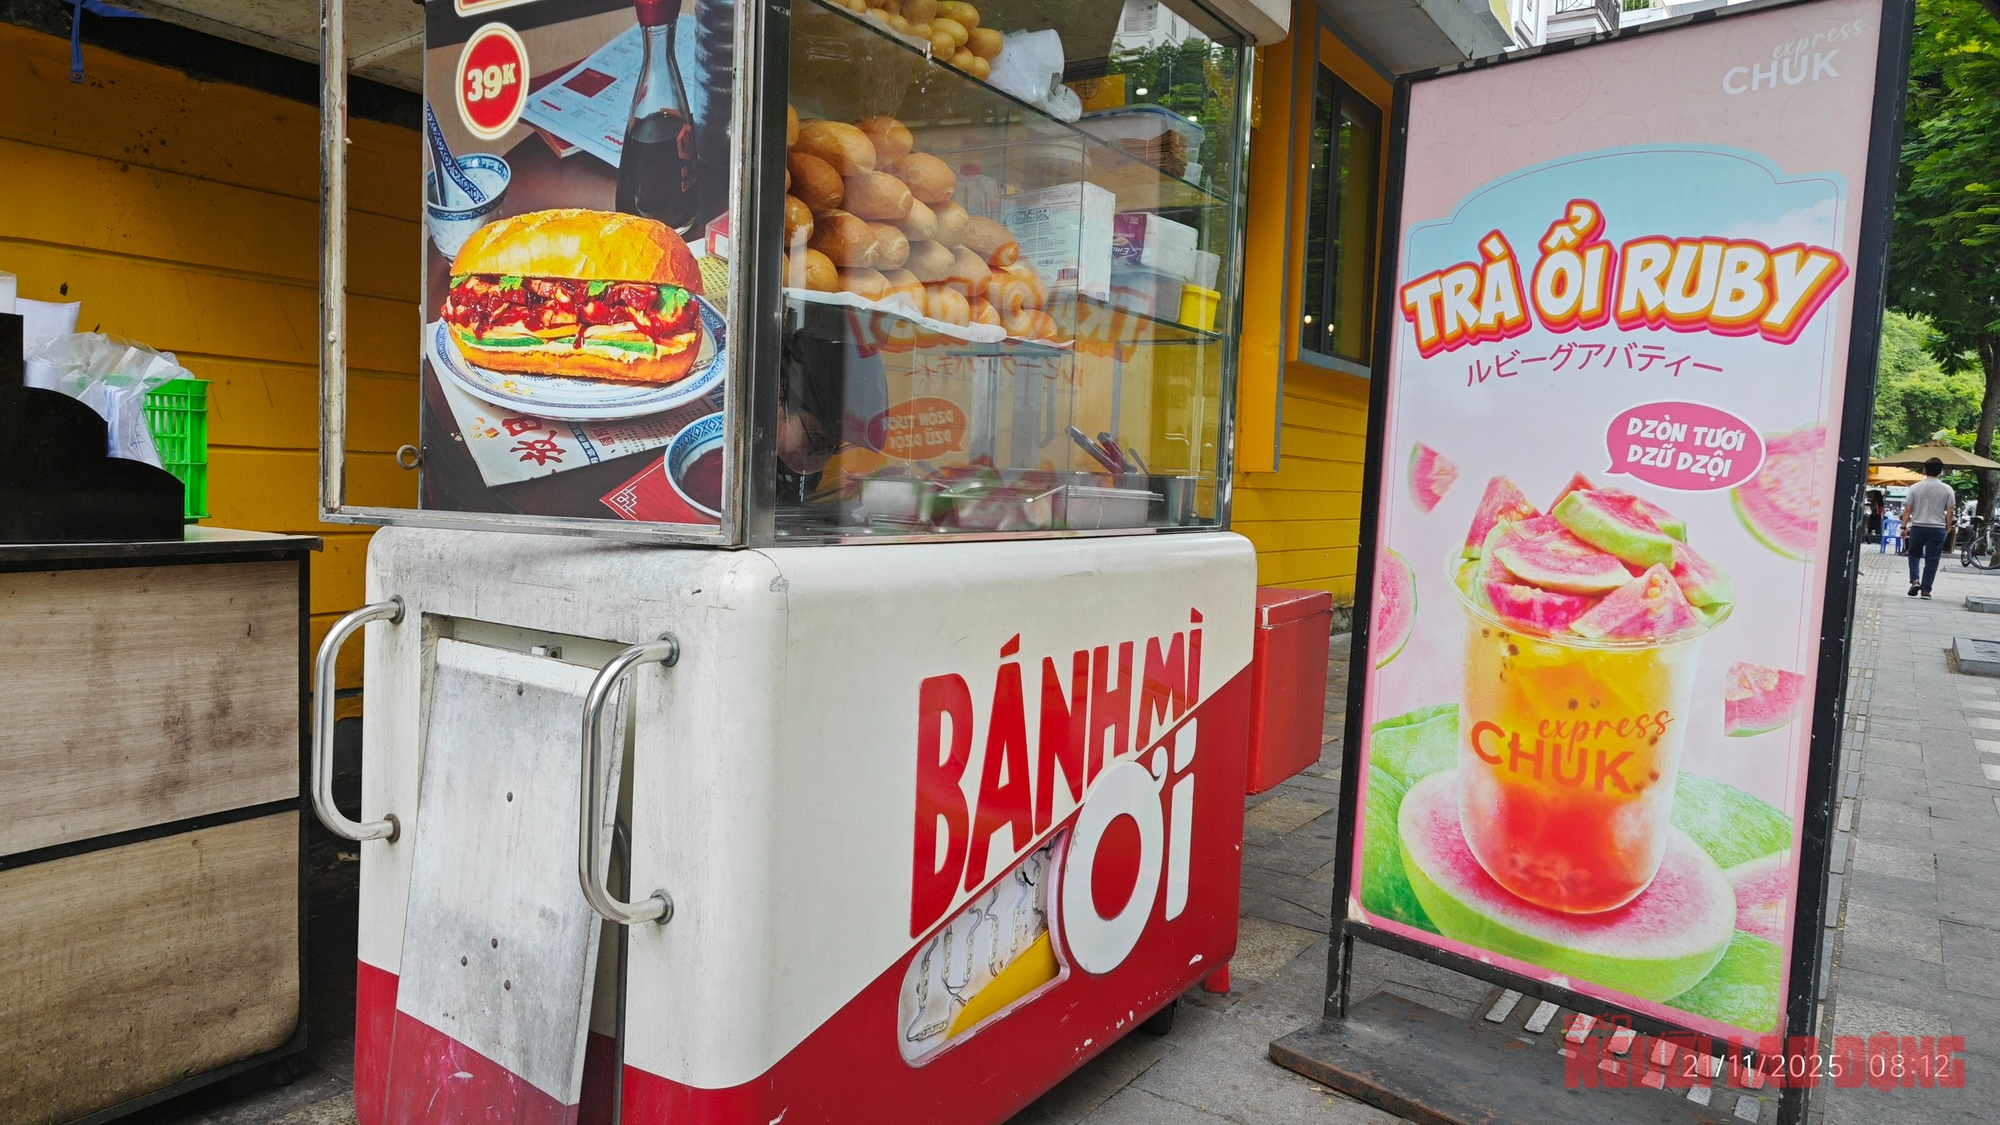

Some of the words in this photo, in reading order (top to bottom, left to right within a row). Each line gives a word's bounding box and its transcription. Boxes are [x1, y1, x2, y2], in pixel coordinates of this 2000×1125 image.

[1772, 19, 1867, 68] express
[467, 62, 516, 102] 39K
[1722, 48, 1840, 95] CHUK
[1403, 233, 1524, 350] TRÀ
[1534, 202, 1611, 324] ỔI
[1616, 240, 1840, 336] RUBY
[1466, 341, 1724, 388] ルビーグアバティー
[1627, 414, 1688, 442] DZÒN
[1693, 427, 1747, 451] TƯƠI
[1627, 443, 1676, 468] DZỮ
[1676, 450, 1733, 482] DZỘI
[1471, 720, 1636, 795] CHUK
[1537, 710, 1675, 763] express
[911, 632, 1134, 939] BÁNH
[1135, 606, 1204, 752] MÌ
